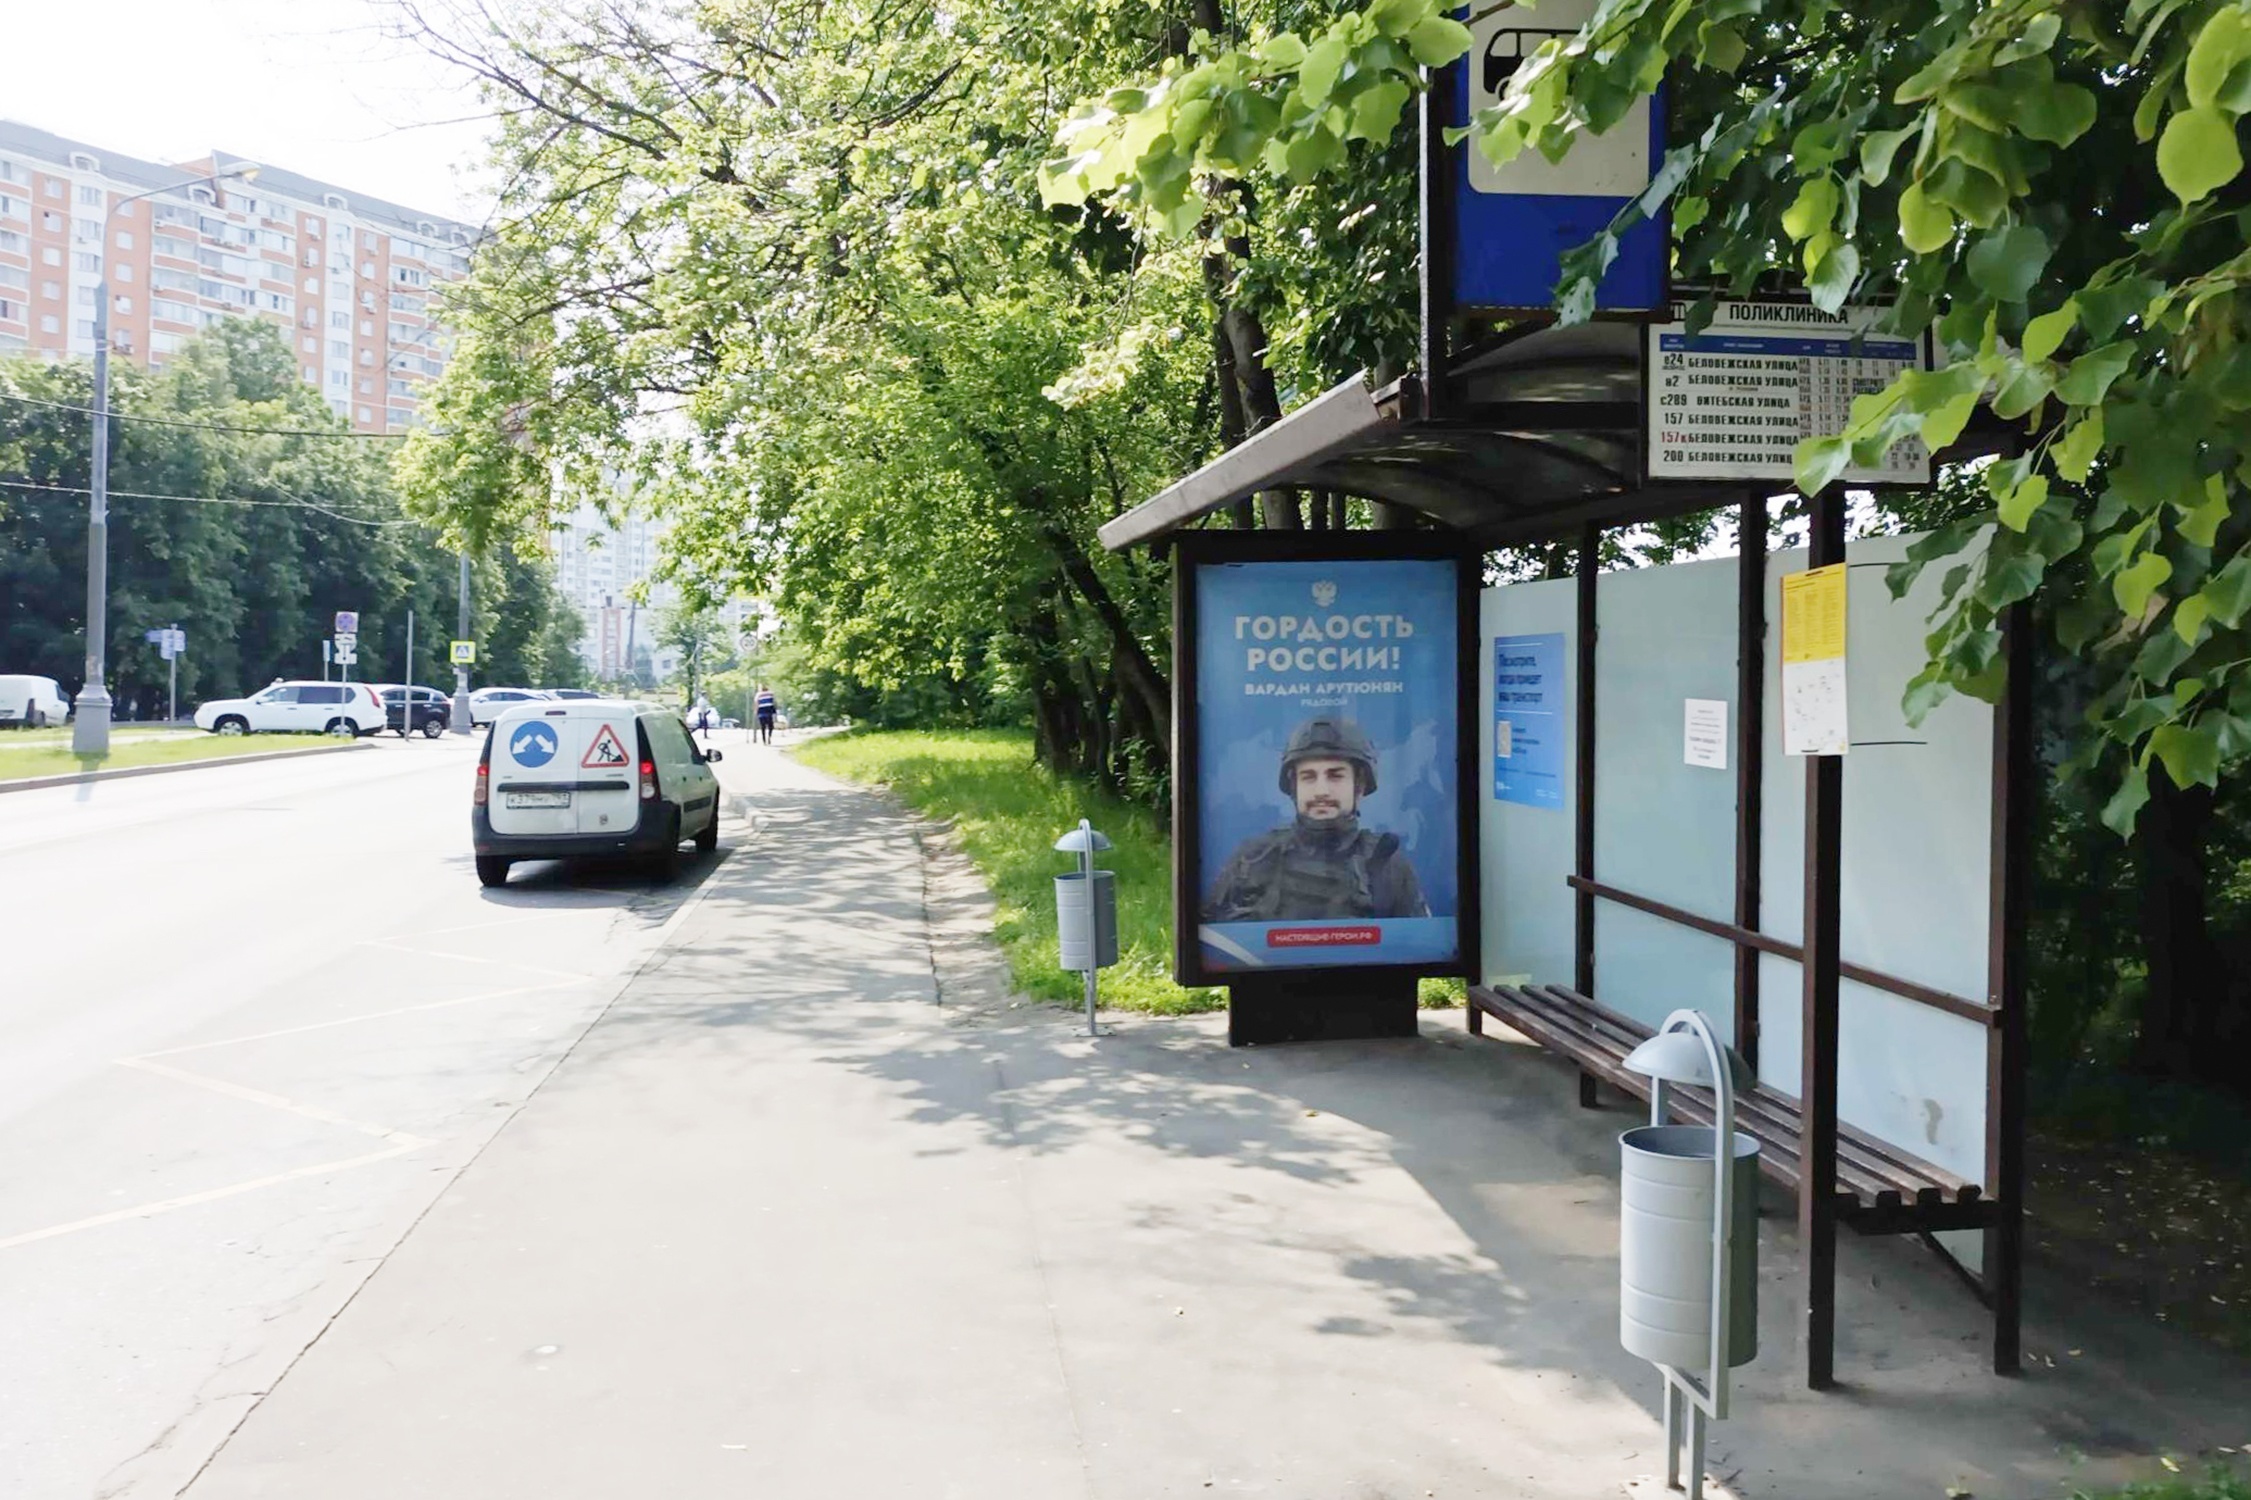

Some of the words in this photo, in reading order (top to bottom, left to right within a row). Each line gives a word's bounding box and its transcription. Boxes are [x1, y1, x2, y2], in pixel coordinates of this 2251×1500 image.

[1729, 304, 1849, 324] ПОЛИКЛИНИКА
[1688, 357, 1762, 370] БЕЛОВЕЖСКАЯ
[1765, 360, 1798, 372] УЛИЦА
[1688, 374, 1762, 387] БЕЛОВЕЖСКАЯ
[1765, 376, 1798, 389] УЛИЦА
[1660, 394, 1688, 407] с289
[1696, 396, 1754, 408] ВИТЕБСКАЯ
[1757, 397, 1790, 408] УЛИЦА
[1664, 412, 1683, 425] 157
[1688, 413, 1762, 426] БЕЛОВЕЖСКАЯ
[1765, 416, 1798, 427] УЛИЦА
[1688, 432, 1762, 444] БЕЛОВЕЖСКАЯ
[1765, 434, 1799, 446] УЛИЦА
[1663, 450, 1684, 462] 200
[1688, 451, 1762, 463] БЕЛОВЕЖСКАЯ
[1765, 453, 1793, 465] УЛИЦ
[1235, 614, 1414, 642] ГОРДОСТЬ
[1247, 647, 1401, 671] РОССИИ!
[1244, 682, 1310, 696] ВАРДАН
[1316, 681, 1403, 695] АРУТЮНЯН
